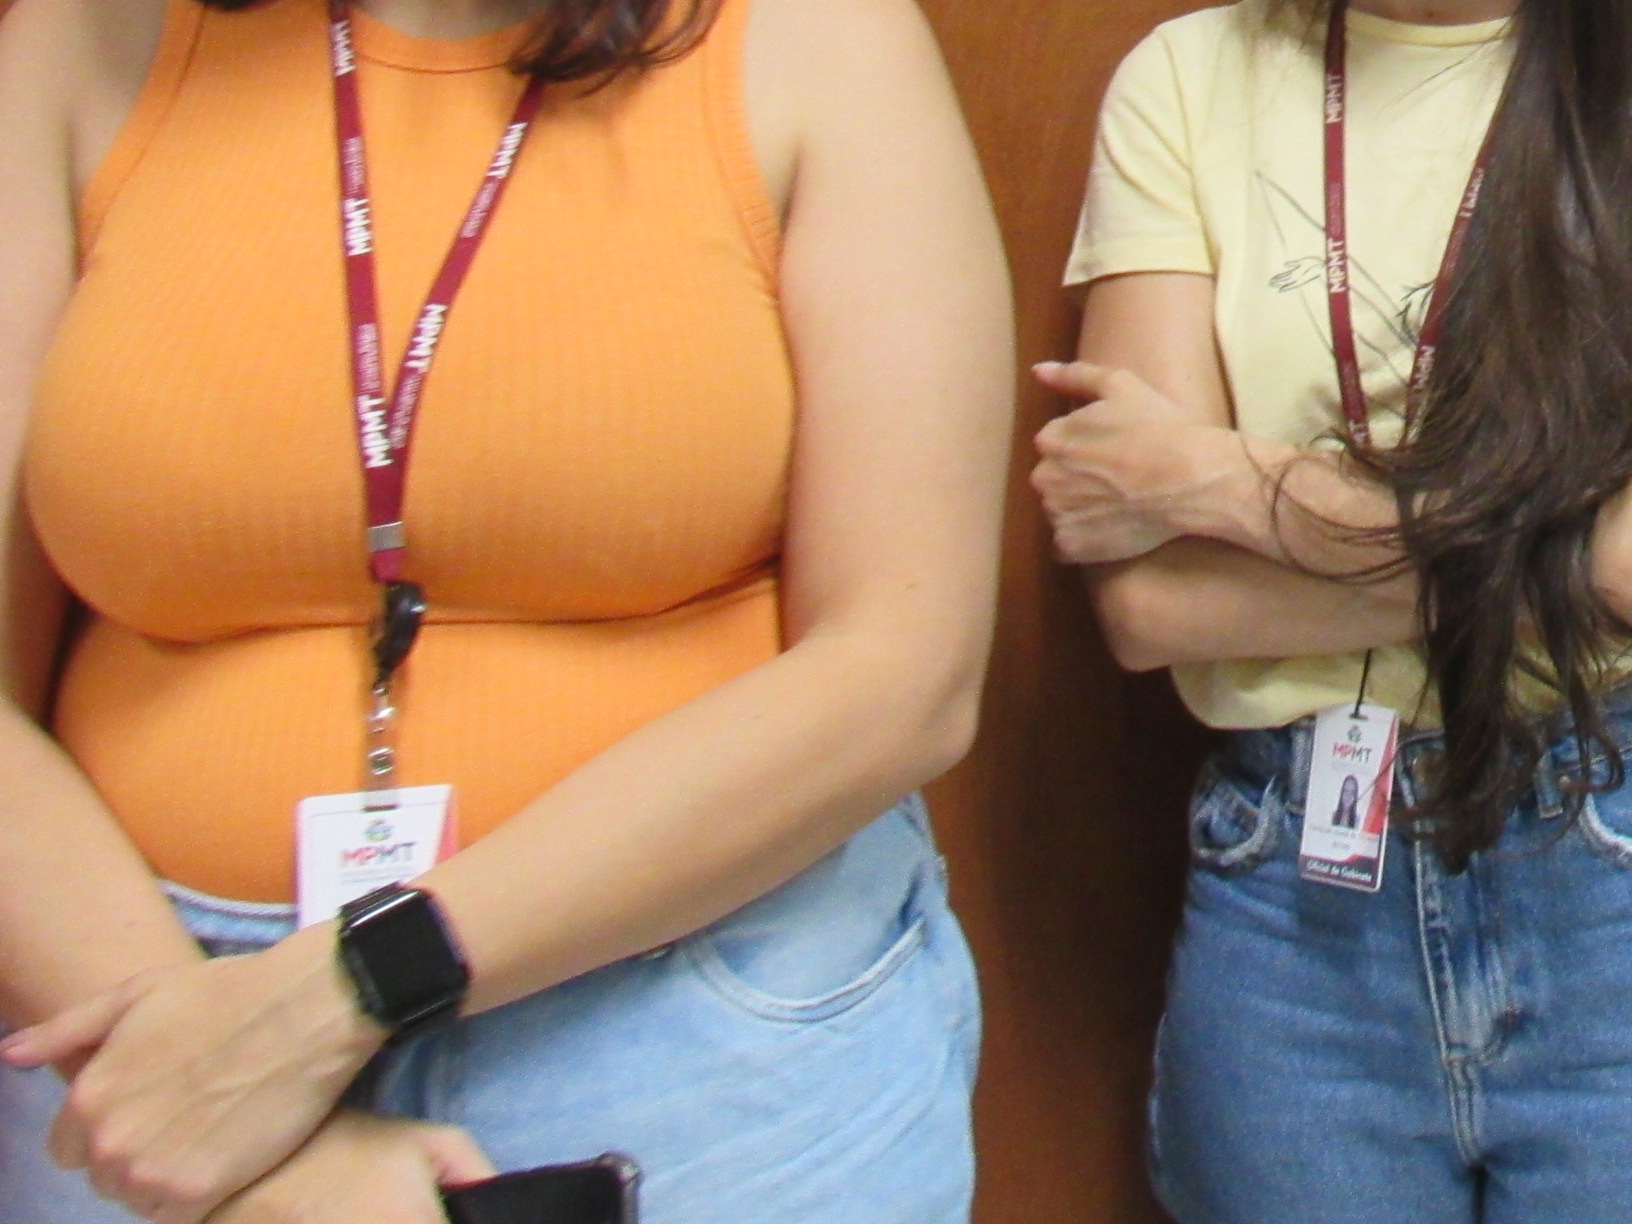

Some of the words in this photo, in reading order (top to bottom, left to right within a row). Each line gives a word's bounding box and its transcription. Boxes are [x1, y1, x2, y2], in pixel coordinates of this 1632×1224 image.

[331, 19, 356, 76] MPMT
[1326, 74, 1342, 123] MPMT
[486, 122, 529, 179] MPMT
[343, 197, 373, 256] MPMT
[1327, 238, 1346, 293] MPMT
[404, 303, 449, 373] MPMT
[357, 392, 395, 468] MPMT
[1333, 742, 1373, 763] MPMT
[340, 840, 417, 867] MPMT
